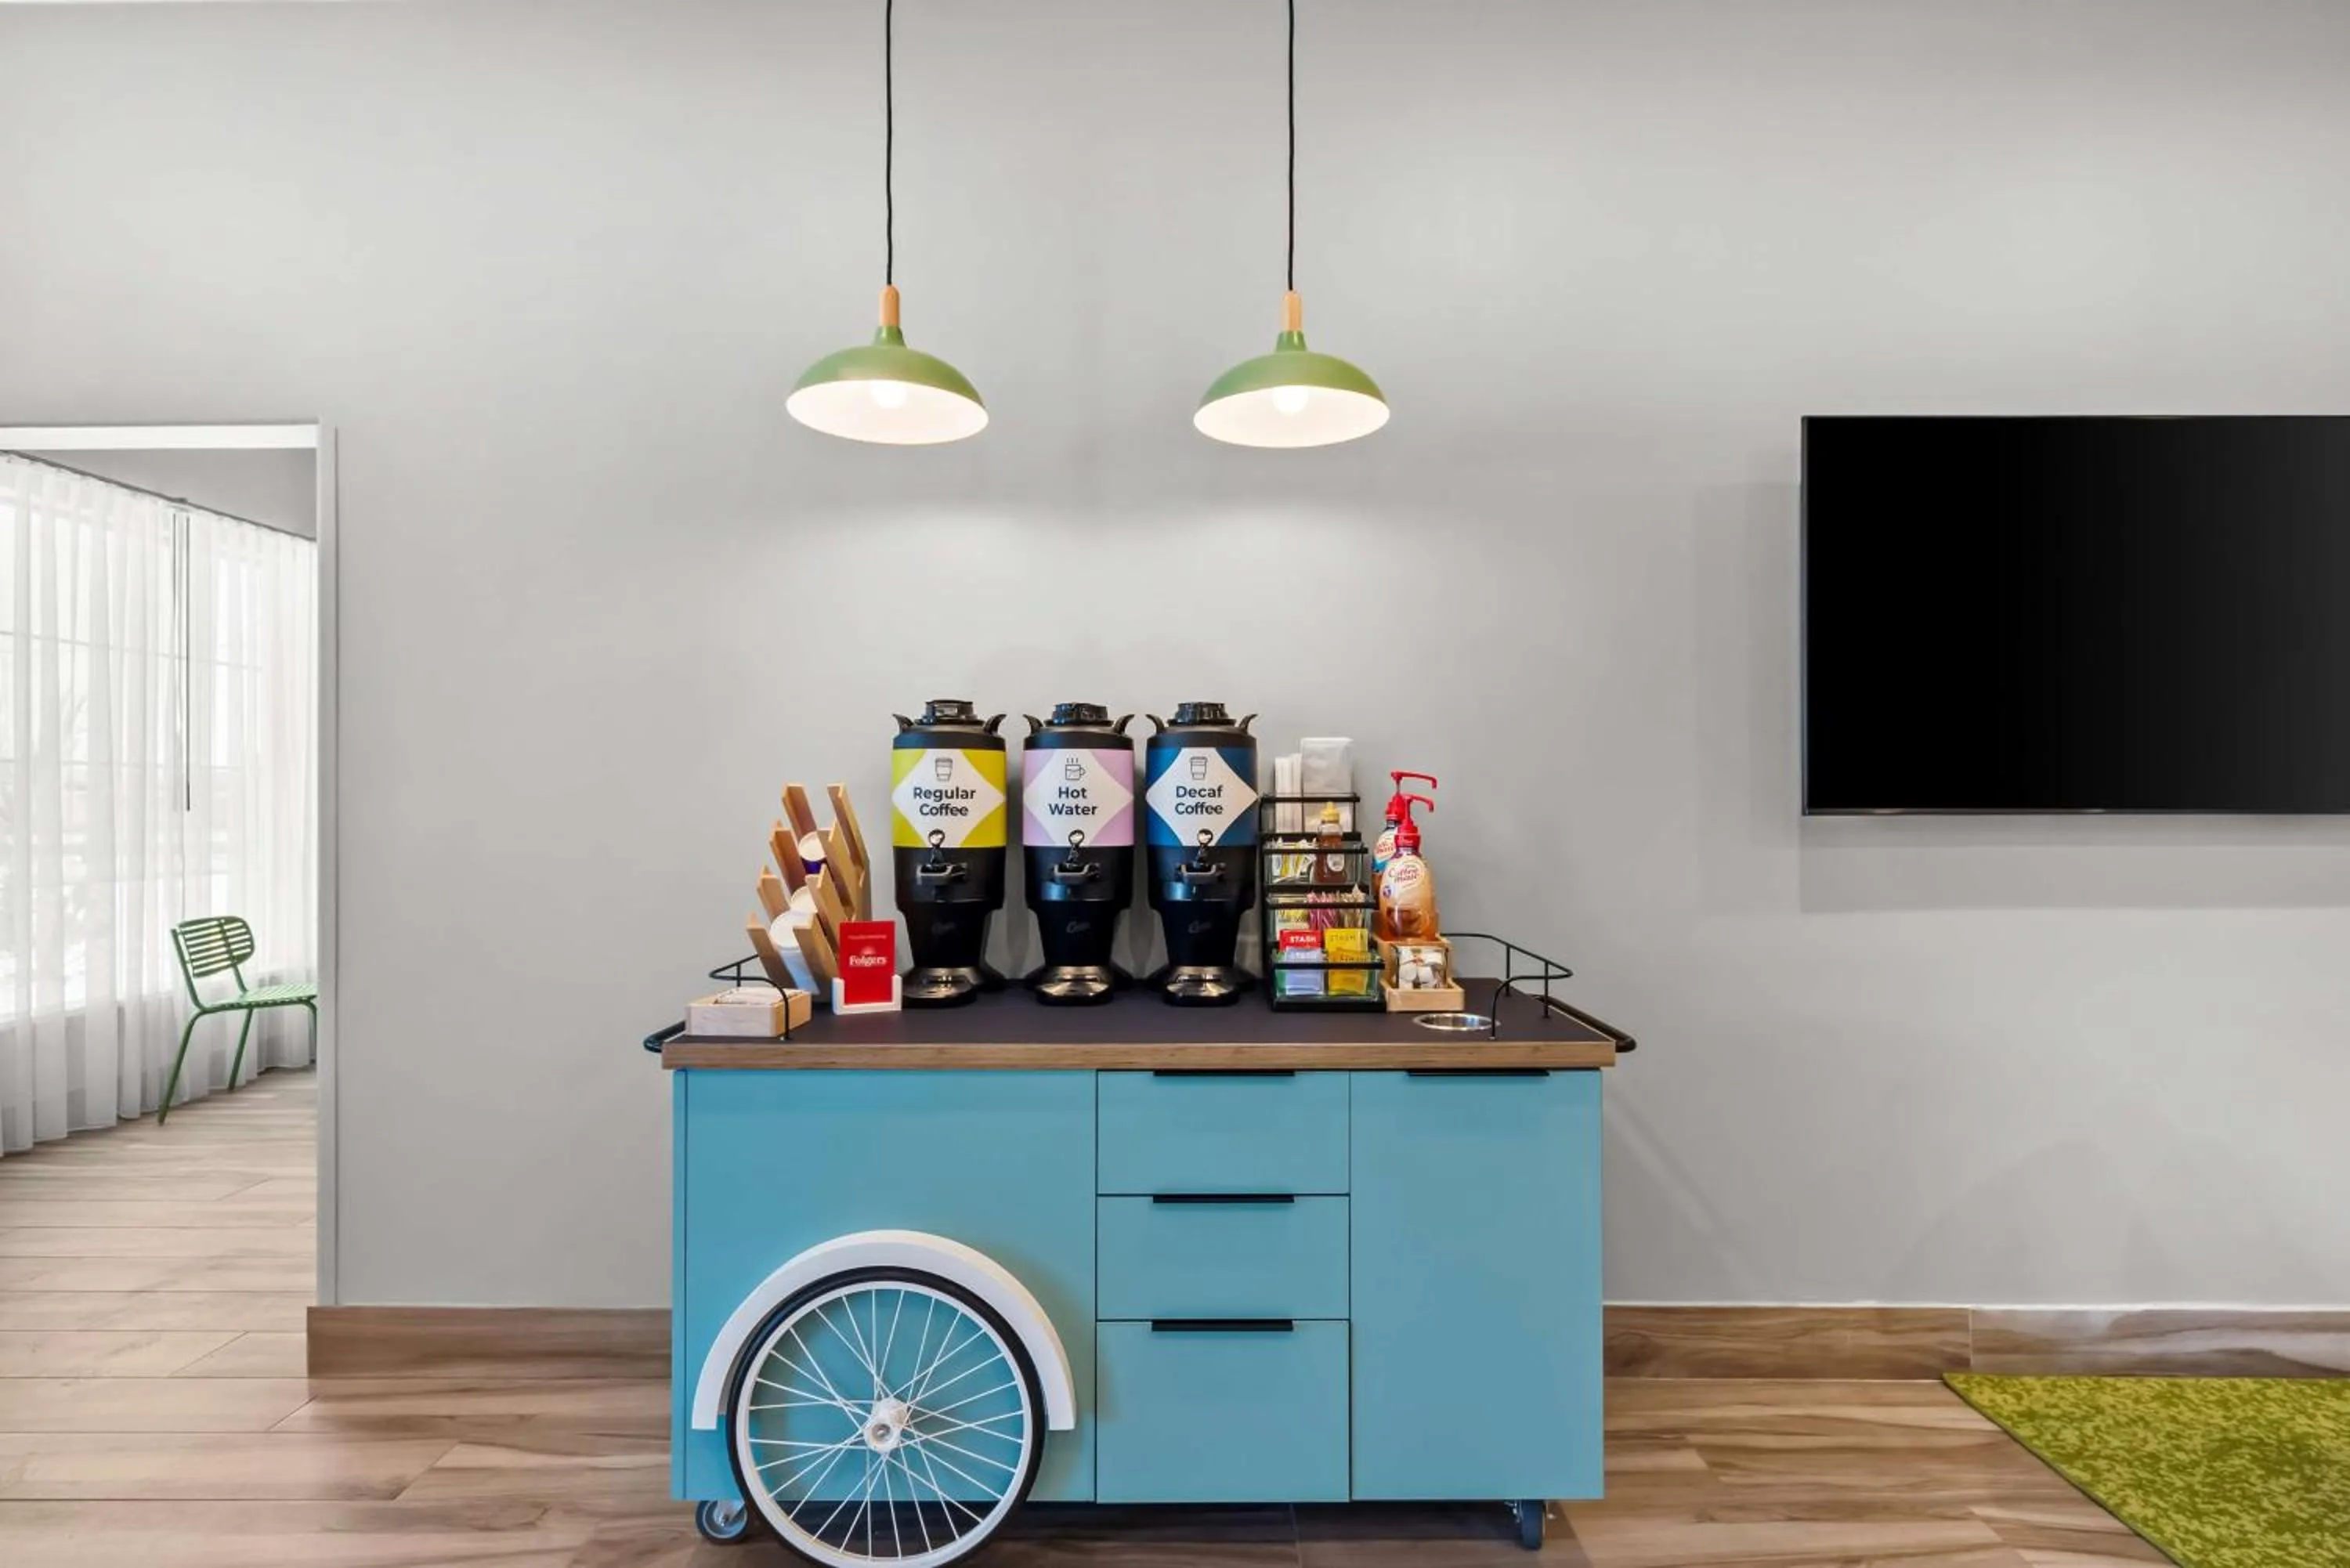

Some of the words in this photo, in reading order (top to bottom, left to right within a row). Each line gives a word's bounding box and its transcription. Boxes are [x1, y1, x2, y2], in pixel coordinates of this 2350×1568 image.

[913, 786, 976, 803] Regular
[1058, 786, 1087, 800] Hot
[1176, 785, 1223, 798] Decaf
[919, 803, 969, 816] Coffee
[1048, 804, 1098, 815] Water
[1175, 802, 1224, 815] Coffee
[849, 955, 888, 967] Folgers
